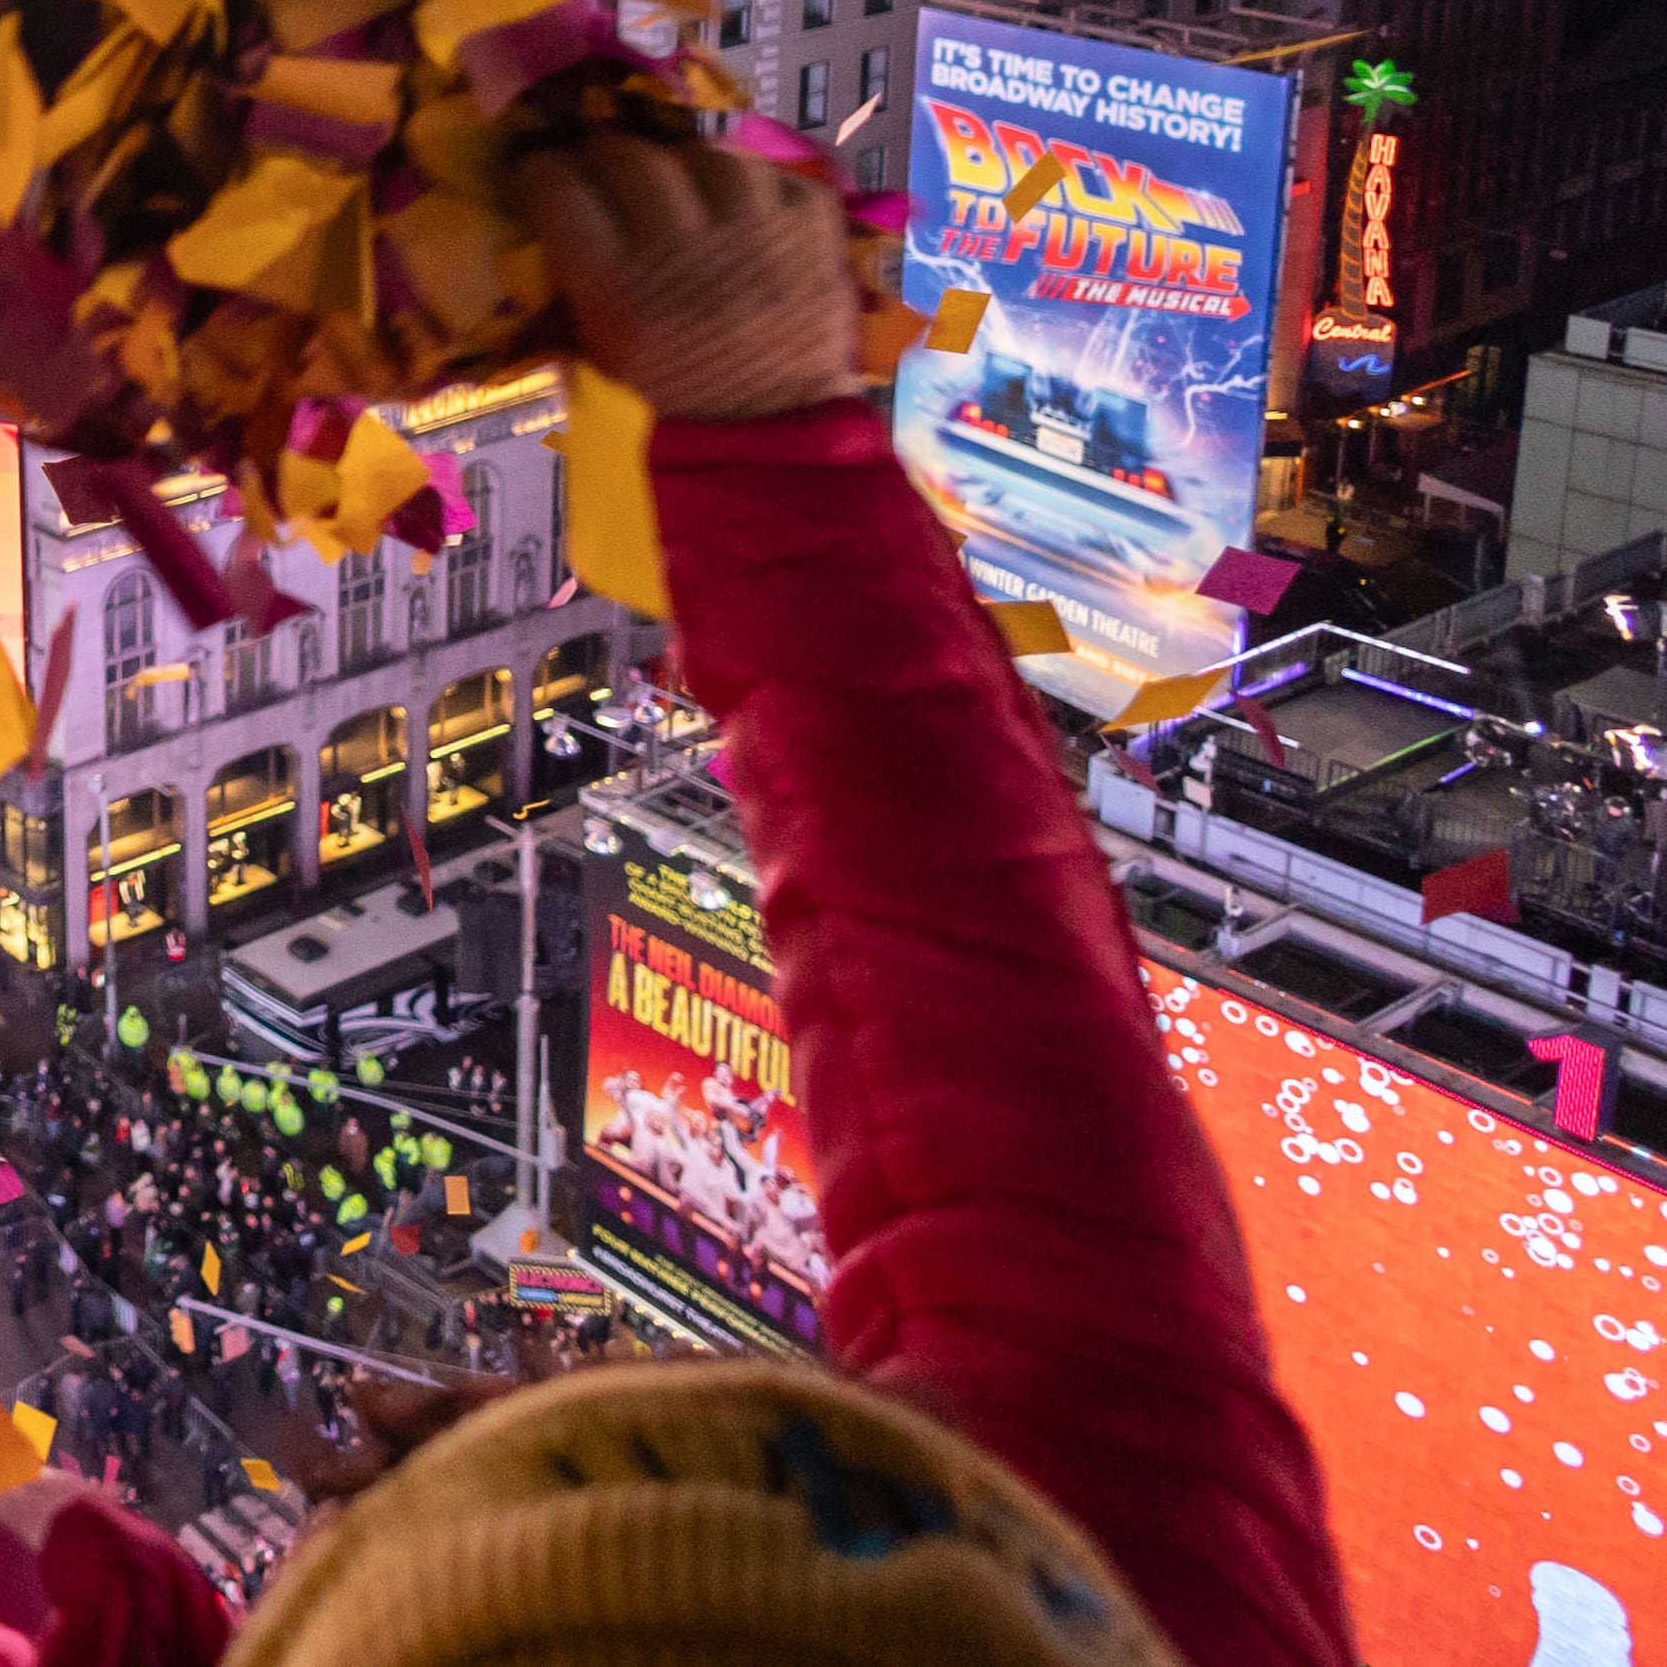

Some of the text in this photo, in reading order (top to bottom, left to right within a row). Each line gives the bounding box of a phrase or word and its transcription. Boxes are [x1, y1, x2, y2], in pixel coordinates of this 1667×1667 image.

[931, 61, 1244, 152] BROADWAY HISTORY!
[933, 36, 1246, 124] IT'S TIME TO CHANGE
[939, 207, 1244, 295] THE FUTURE
[950, 189, 1008, 232] TO
[1362, 133, 1399, 308] HAVANA
[1073, 280, 1233, 316] THE MUSICAL
[1312, 316, 1393, 342] Central
[967, 555, 1025, 599] WINTER
[1091, 611, 1160, 659] THEATRE
[607, 913, 646, 963] THE
[647, 934, 696, 991] NEIL
[699, 961, 789, 1042] DIAMON
[607, 951, 796, 1108] A BEAUTIFUL
